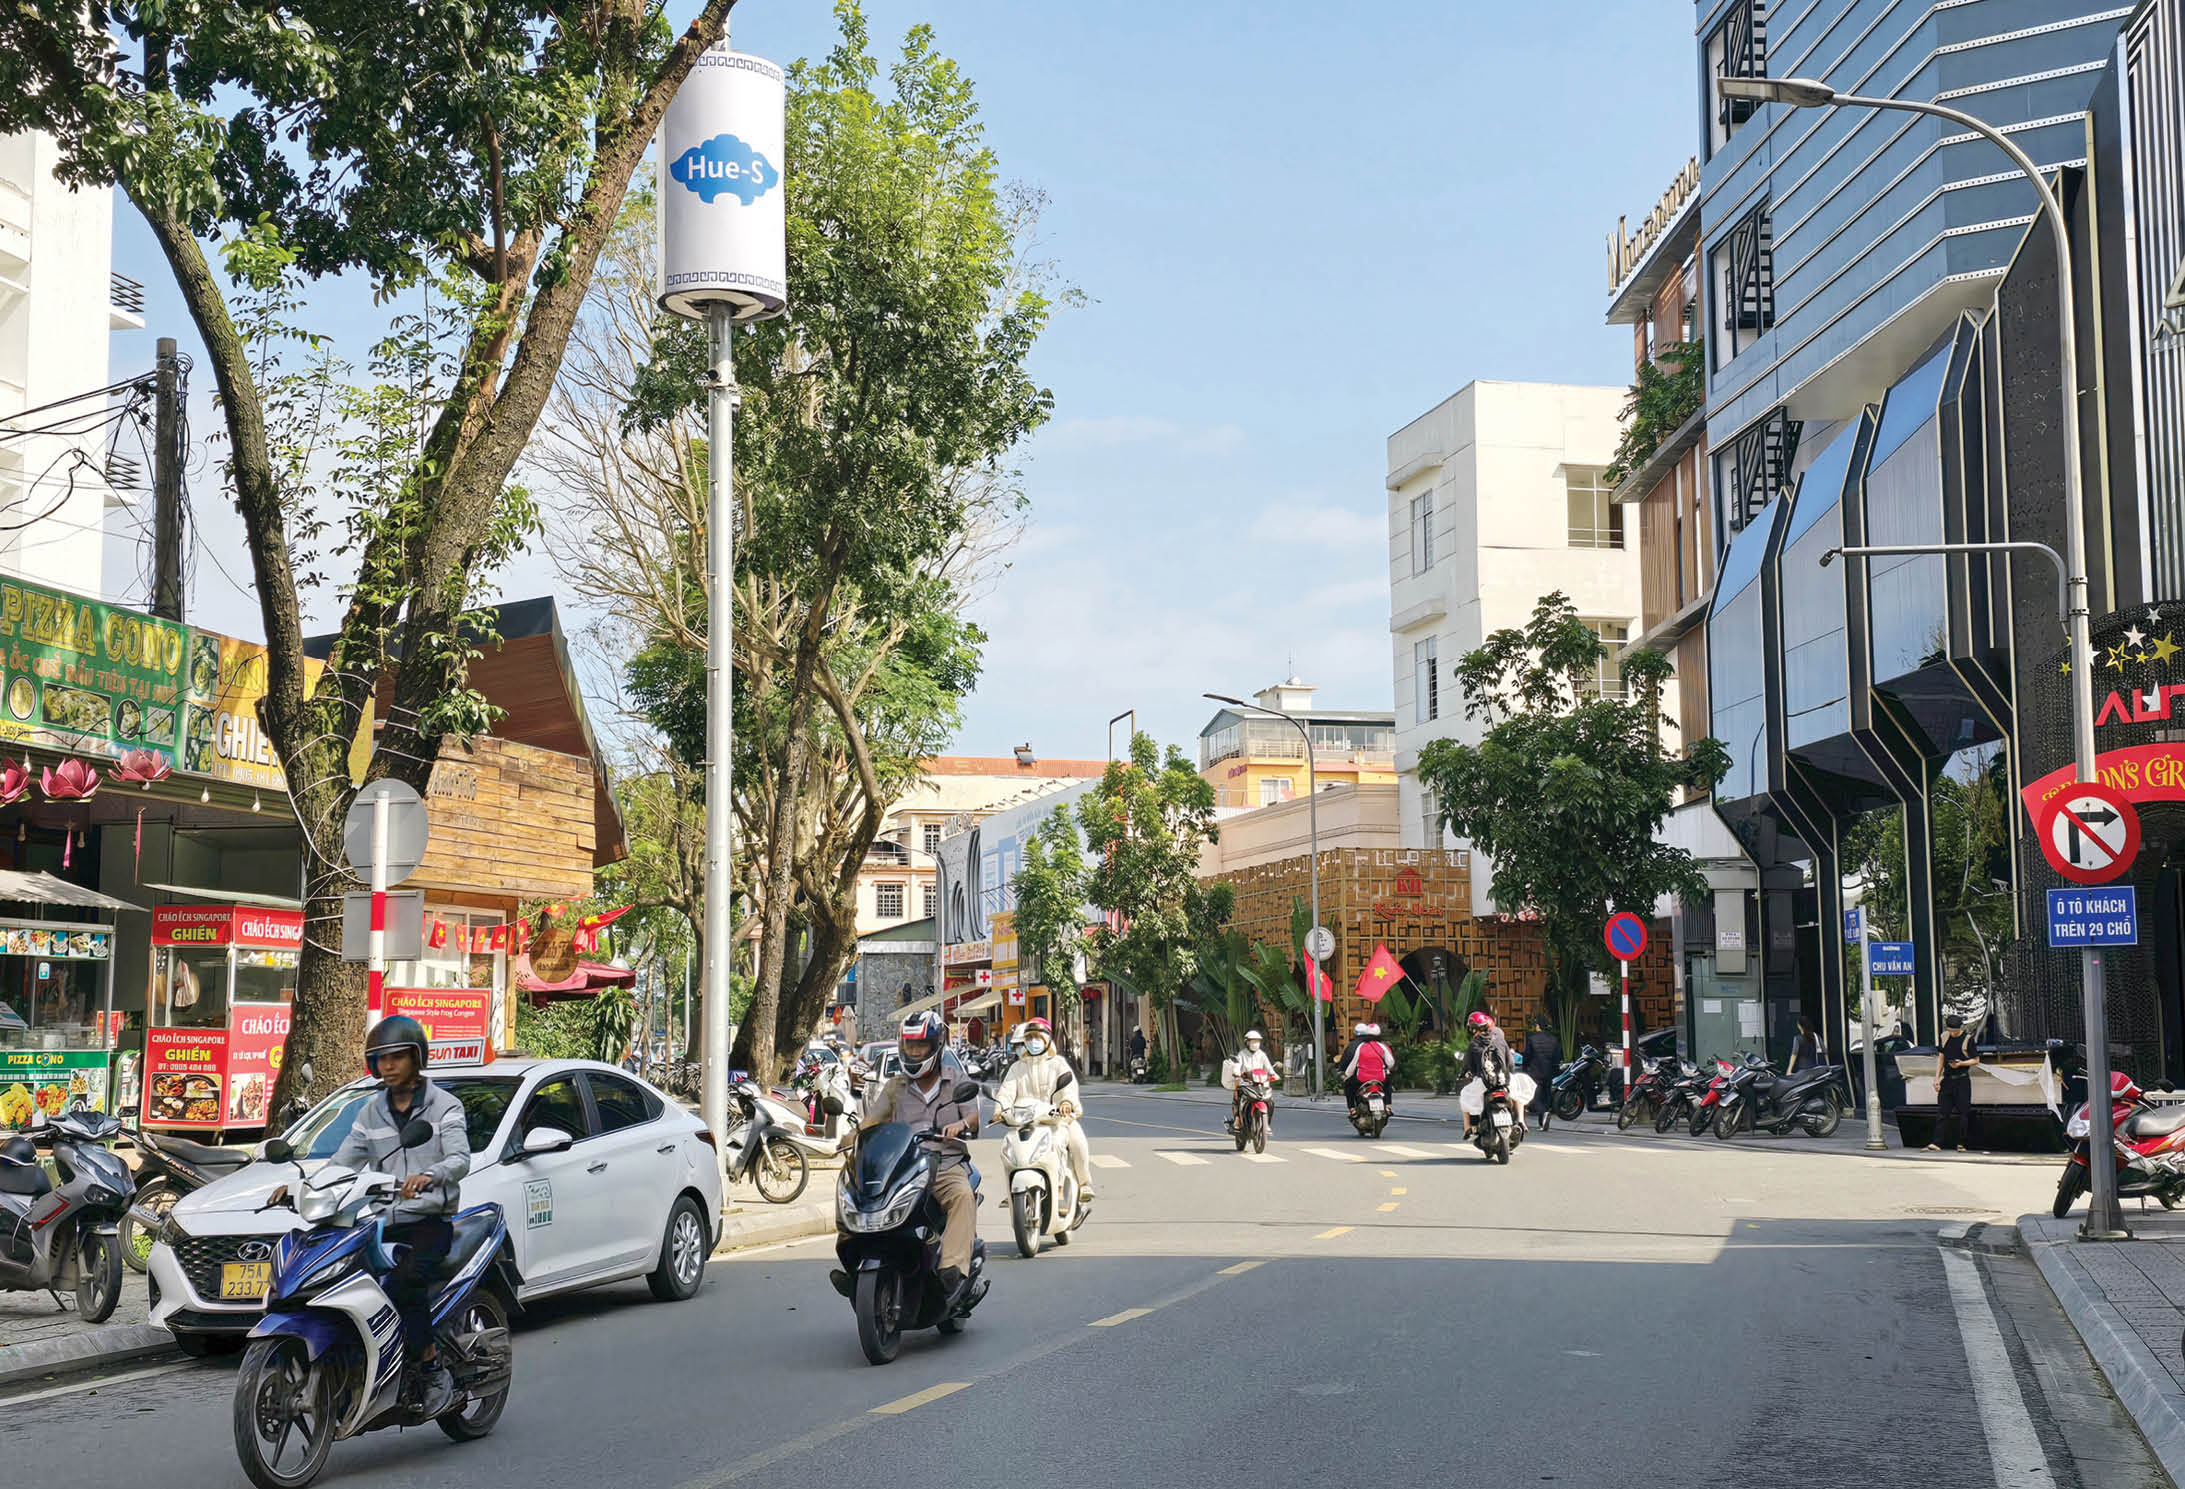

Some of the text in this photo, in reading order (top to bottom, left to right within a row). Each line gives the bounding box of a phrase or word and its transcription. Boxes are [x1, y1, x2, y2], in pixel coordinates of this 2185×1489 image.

[687, 155, 764, 185] Hue-S
[0, 583, 182, 675] PIZZA CONO
[2057, 896, 2127, 915] Ô TÔ KHÁCH
[193, 913, 231, 922] SINGAPORE
[242, 919, 264, 938] CHÁO
[2054, 915, 2131, 937] TRÊN 29 CHỖ
[1872, 960, 1912, 971] CHU VĂN AN
[435, 999, 482, 1009] SINGAPORE
[242, 1015, 272, 1035] CHÁO
[187, 1035, 225, 1045] SINGAPORE
[7, 1055, 34, 1065] PIZZA
[454, 1046, 479, 1059] TAXI
[240, 1264, 262, 1279] 75A
[227, 1281, 268, 1296] 233.7
